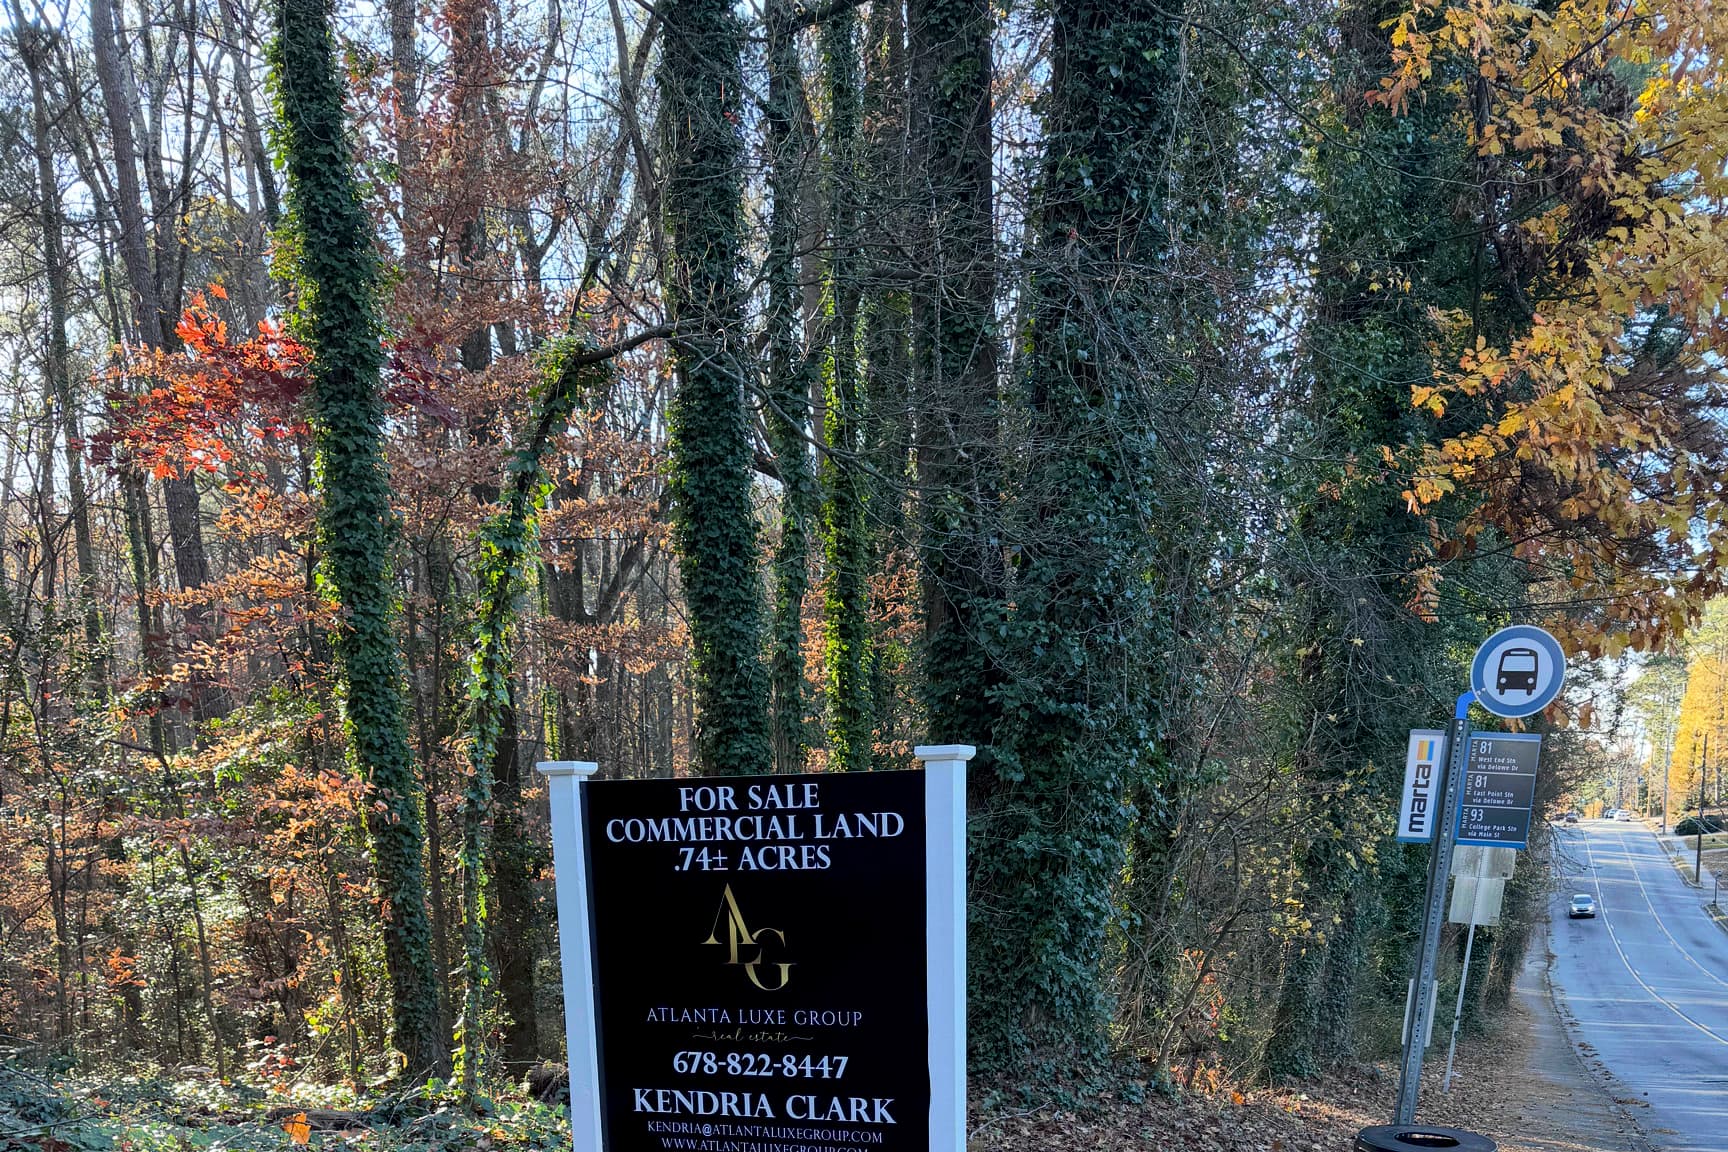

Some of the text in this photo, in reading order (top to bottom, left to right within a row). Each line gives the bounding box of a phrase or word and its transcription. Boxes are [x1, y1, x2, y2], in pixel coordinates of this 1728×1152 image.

[1480, 740, 1493, 755] 81
[1474, 774, 1488, 788] 81
[678, 783, 820, 812] FOR SALE
[1408, 764, 1432, 833] marta
[606, 811, 905, 843] COMMERCIAL LAND
[1470, 808, 1484, 822] 93
[1469, 823, 1491, 832] College
[738, 844, 832, 872] ACRES
[647, 1007, 863, 1026] ATLANTA LUXE GROUP
[711, 1027, 790, 1042] real estate
[673, 1050, 849, 1080] 678-822-8447
[632, 1087, 898, 1124] KENDRIA CLARK
[647, 1120, 883, 1144] KENDRIA@ATLANTALUXEGROUP.COM
